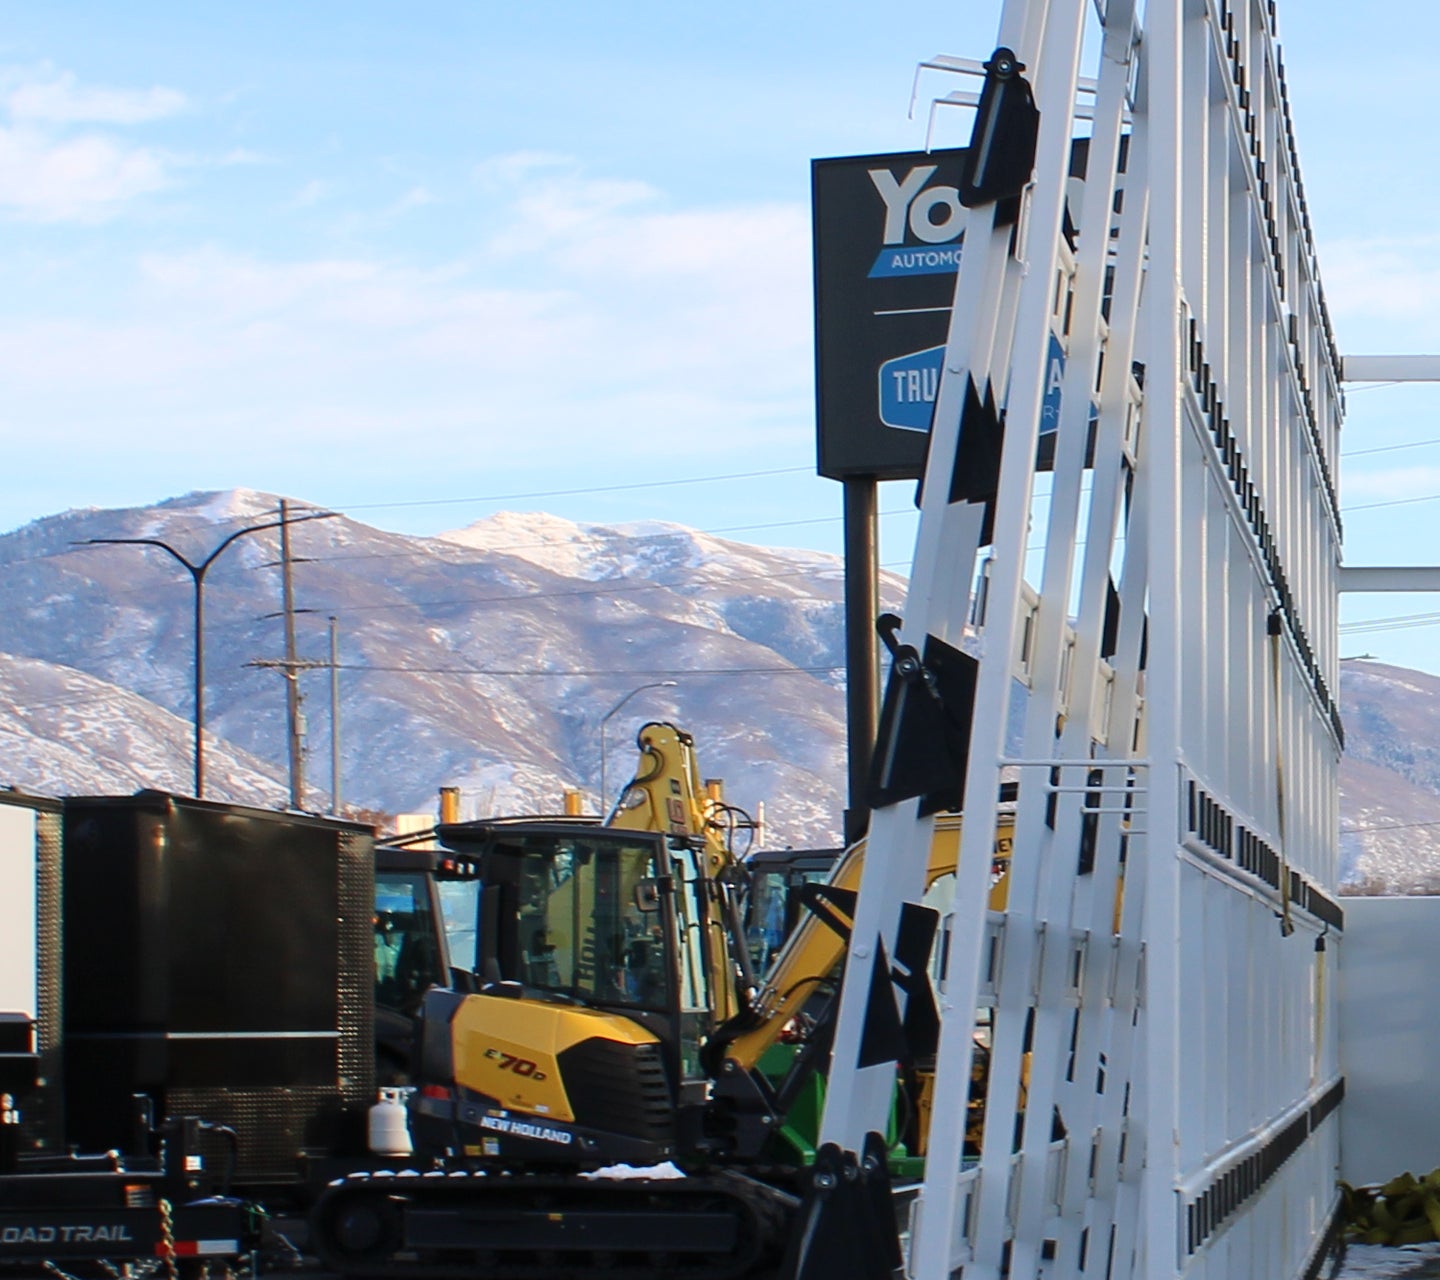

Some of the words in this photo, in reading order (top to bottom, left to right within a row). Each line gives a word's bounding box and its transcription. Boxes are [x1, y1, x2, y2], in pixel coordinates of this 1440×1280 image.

[891, 249, 963, 269] AUTOMO
[480, 1116, 511, 1132] NEW
[510, 1121, 572, 1144] HOLLAND
[60, 1225, 133, 1242] TRAIL
